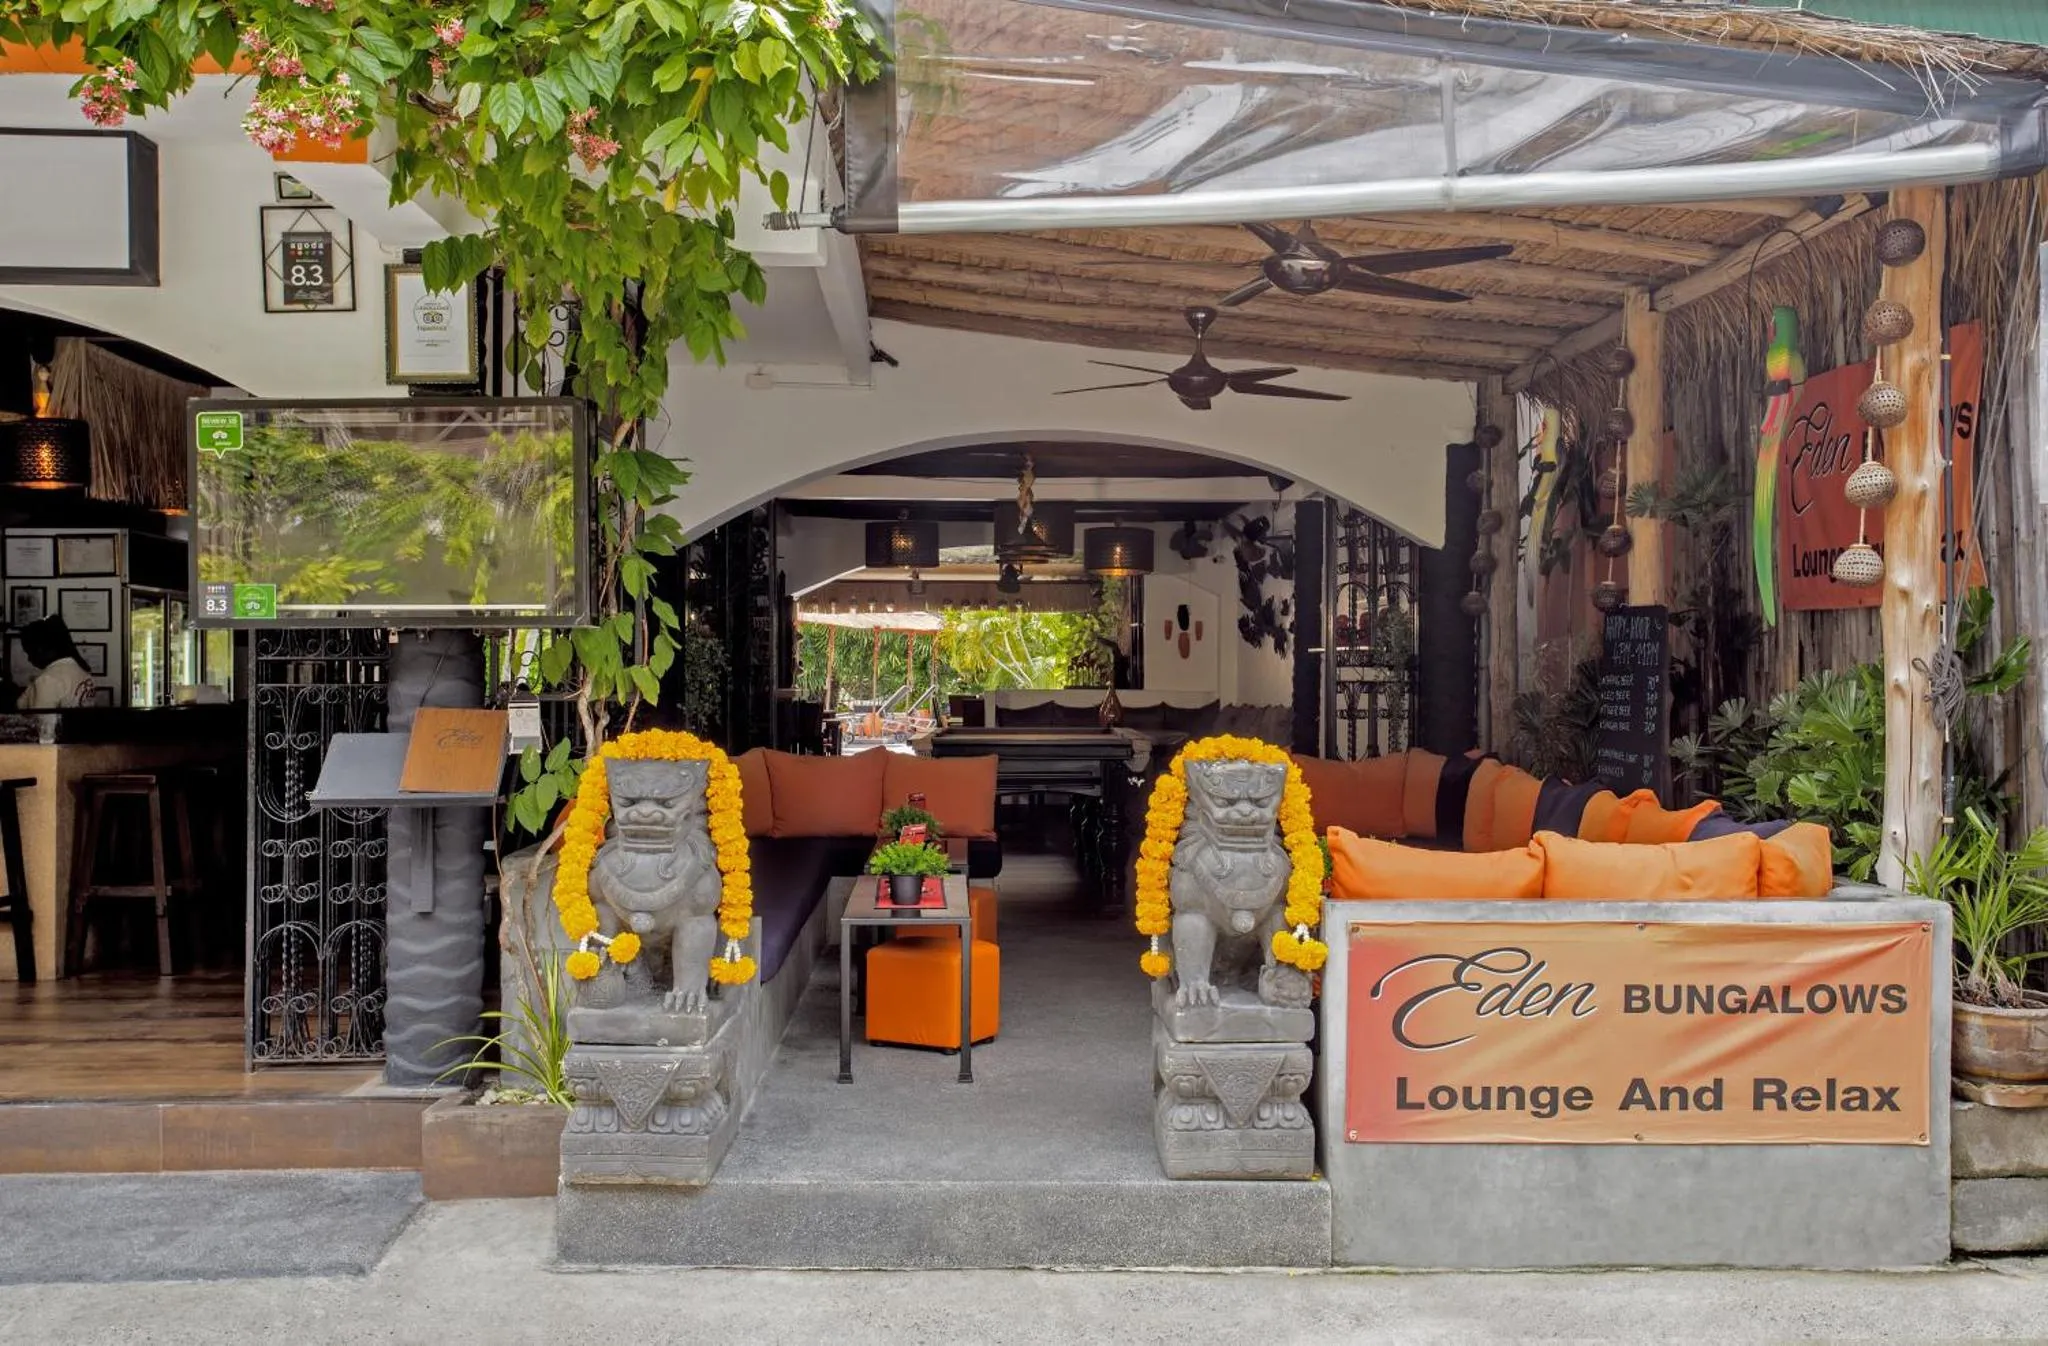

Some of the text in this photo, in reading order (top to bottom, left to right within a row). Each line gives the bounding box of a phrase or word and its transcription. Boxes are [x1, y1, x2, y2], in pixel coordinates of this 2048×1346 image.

[291, 264, 323, 286] 8.3
[1786, 401, 1851, 516] Eden
[1793, 543, 1841, 583] Loung
[206, 599, 227, 611] 8.3
[1370, 946, 1908, 1052] Eden BUNGALOWS
[1396, 1077, 1901, 1119] Lounge And Relax
